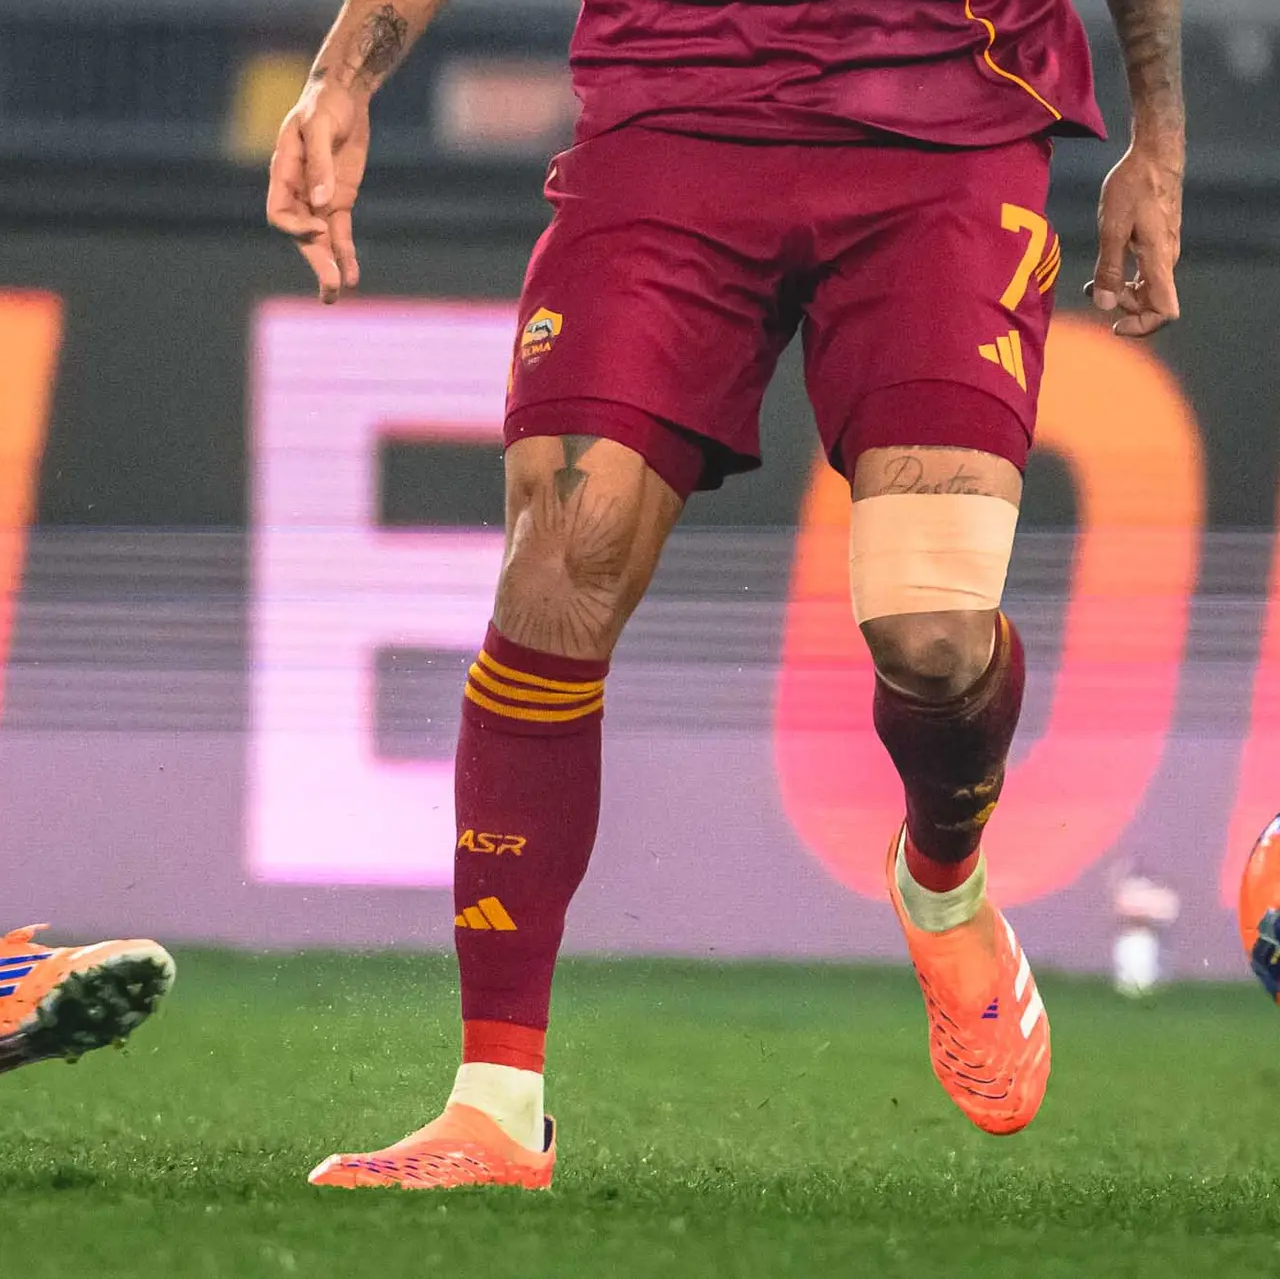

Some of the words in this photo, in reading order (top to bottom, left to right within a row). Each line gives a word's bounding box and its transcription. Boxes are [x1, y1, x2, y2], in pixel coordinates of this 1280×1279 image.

[999, 202, 1048, 312] 7
[248, 297, 519, 887] E
[457, 828, 527, 856] ASR
